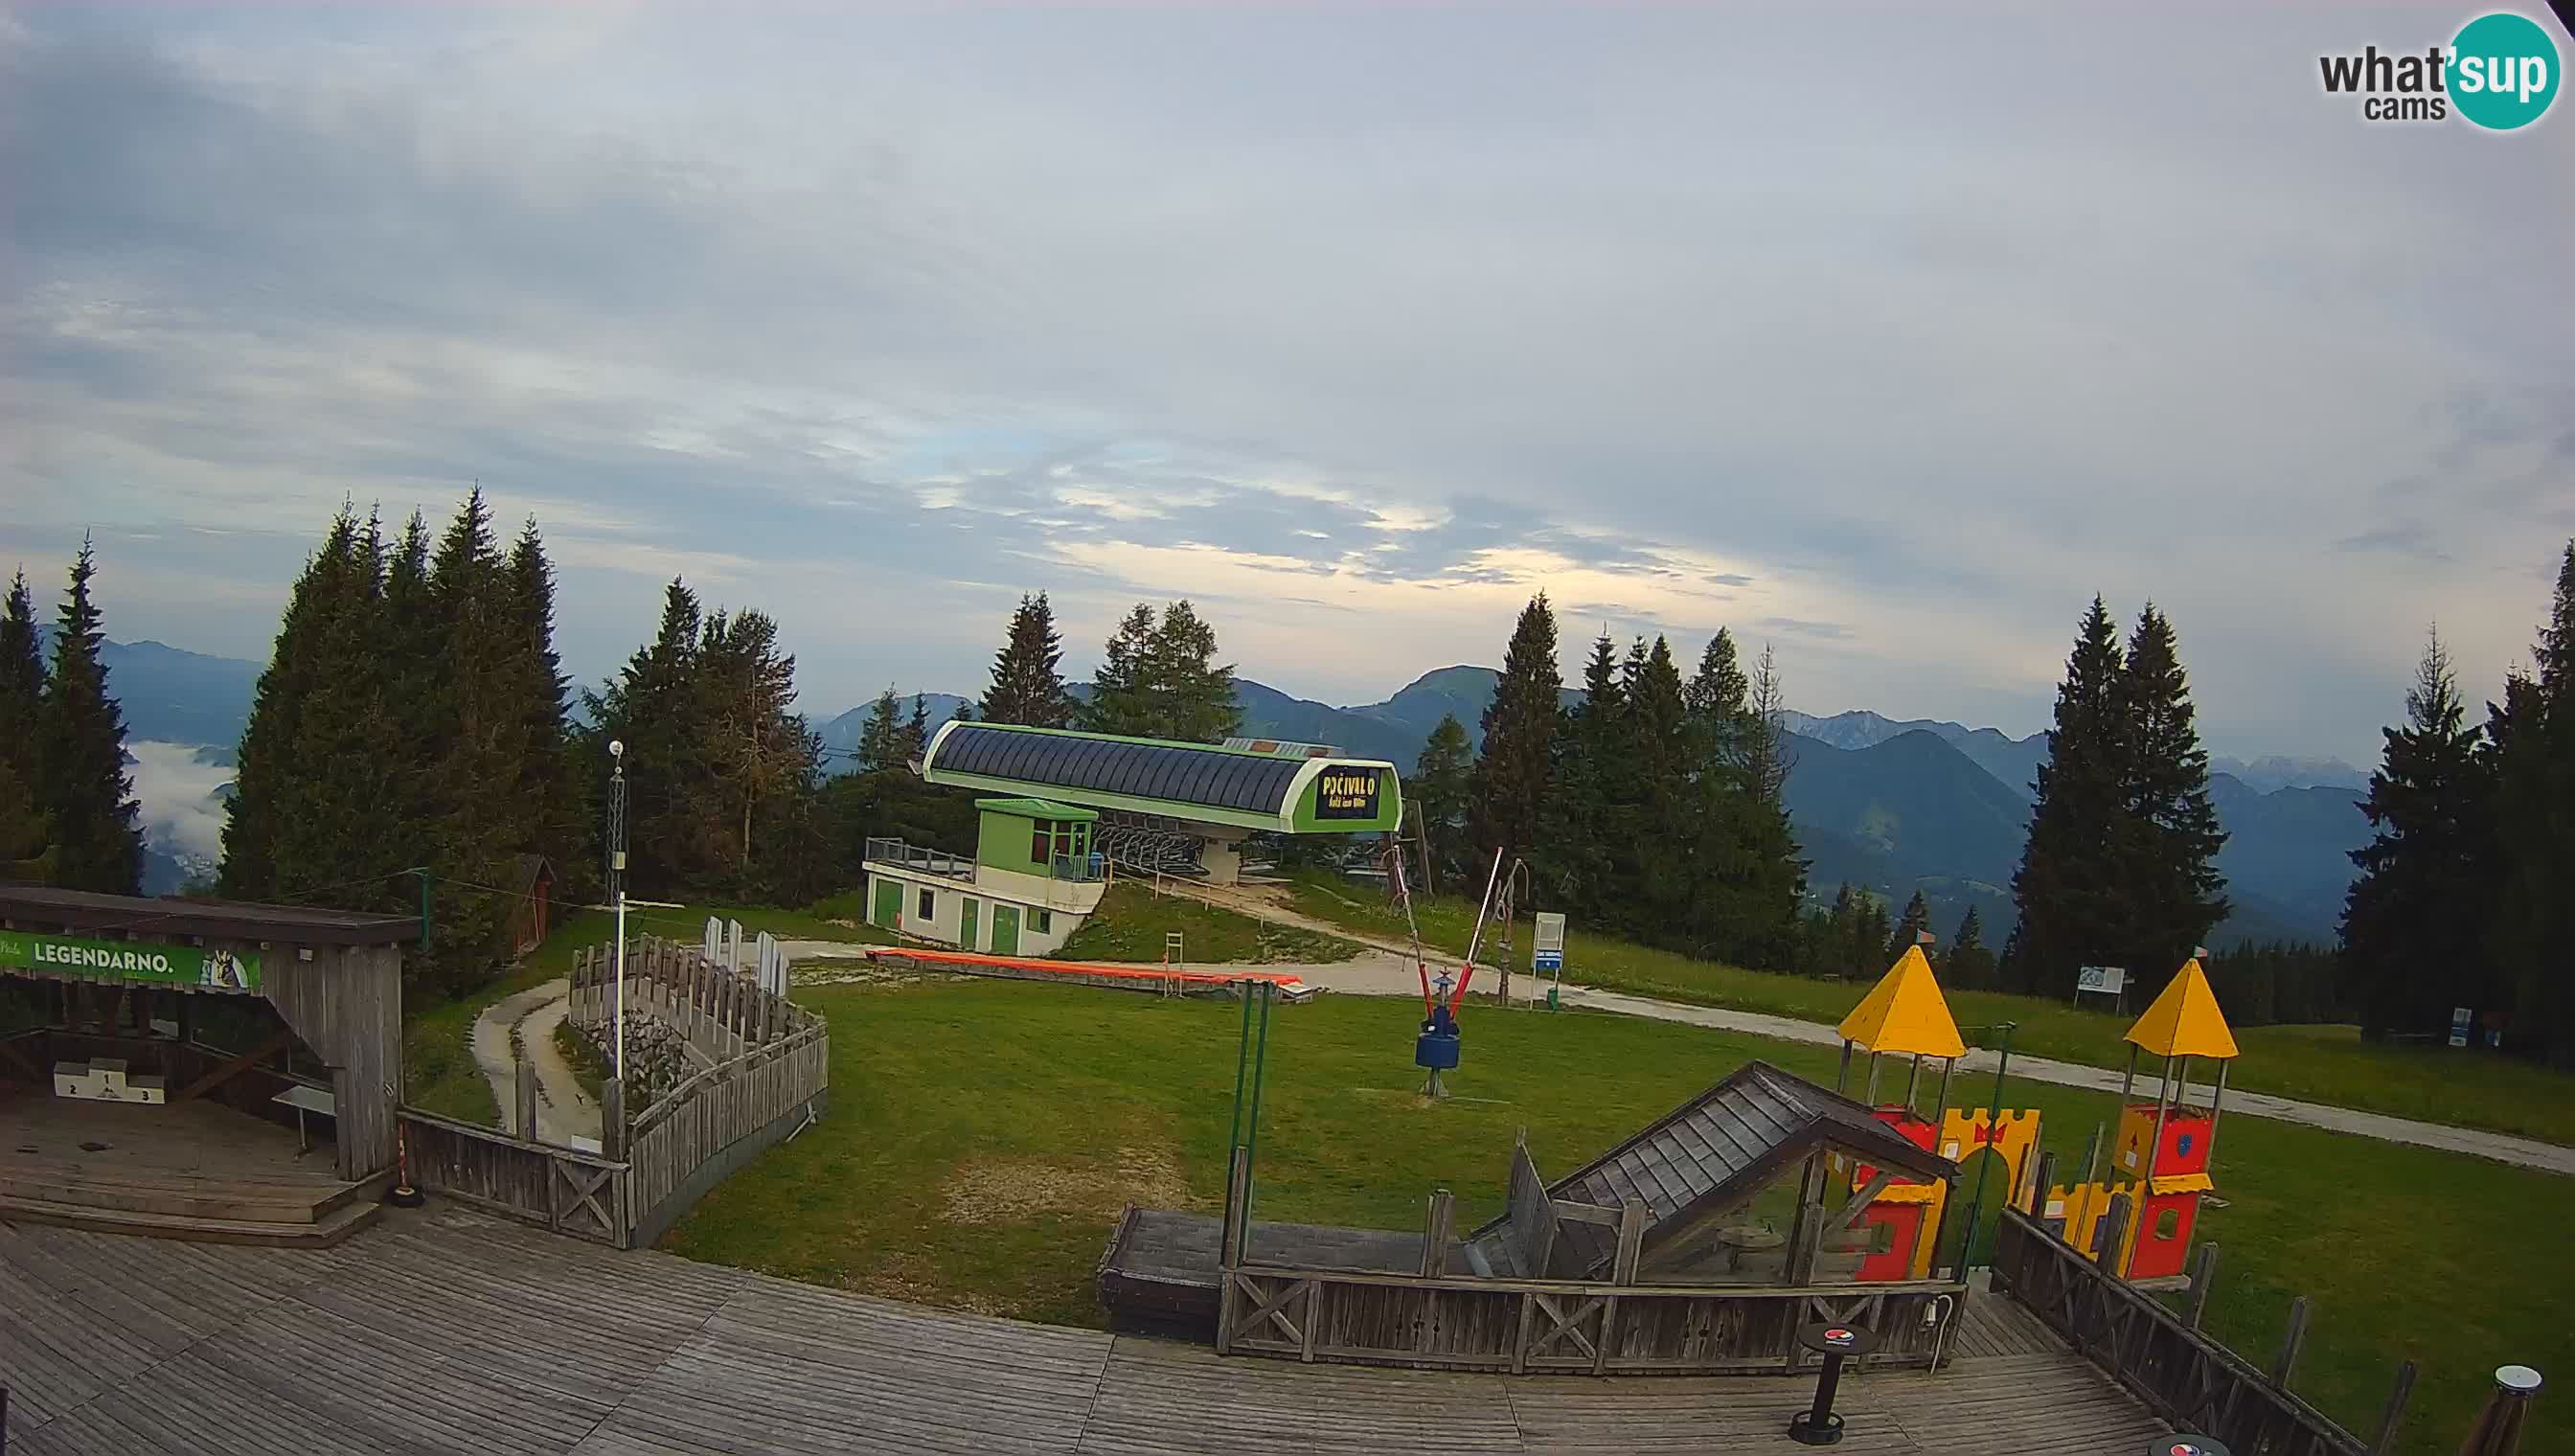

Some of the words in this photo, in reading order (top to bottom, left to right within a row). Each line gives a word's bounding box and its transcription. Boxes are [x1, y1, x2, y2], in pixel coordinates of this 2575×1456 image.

[34, 943, 175, 974] LEGENDARNO.
[103, 1074, 110, 1084] 1
[70, 1084, 78, 1095] 2
[142, 1090, 149, 1102] 3
